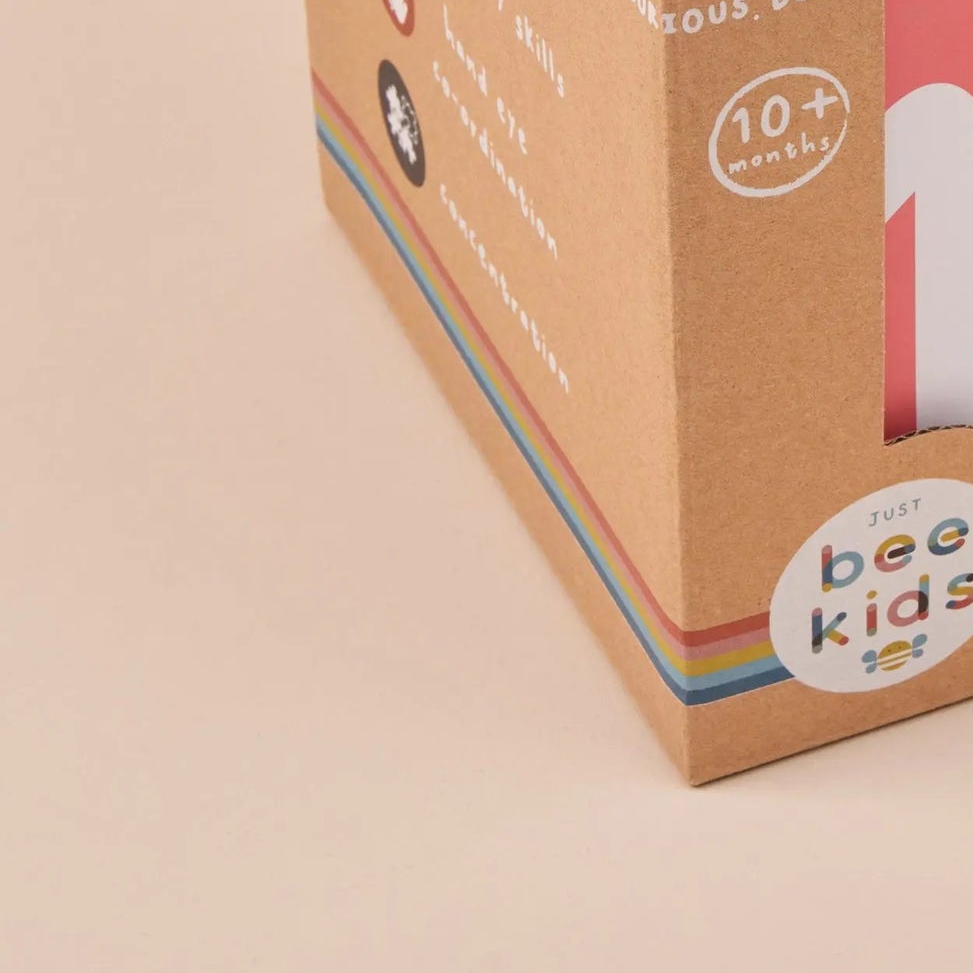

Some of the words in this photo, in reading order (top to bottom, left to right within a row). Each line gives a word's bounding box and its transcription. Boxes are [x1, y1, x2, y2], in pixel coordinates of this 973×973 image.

[443, 3, 488, 97] hand
[496, 96, 528, 156] eye
[515, 14, 565, 98] skills
[728, 132, 831, 175] months
[732, 87, 839, 144] 10+
[432, 60, 558, 260] co-ordination
[439, 183, 569, 394] concentration
[868, 498, 922, 527] JUST
[820, 515, 969, 592] bee
